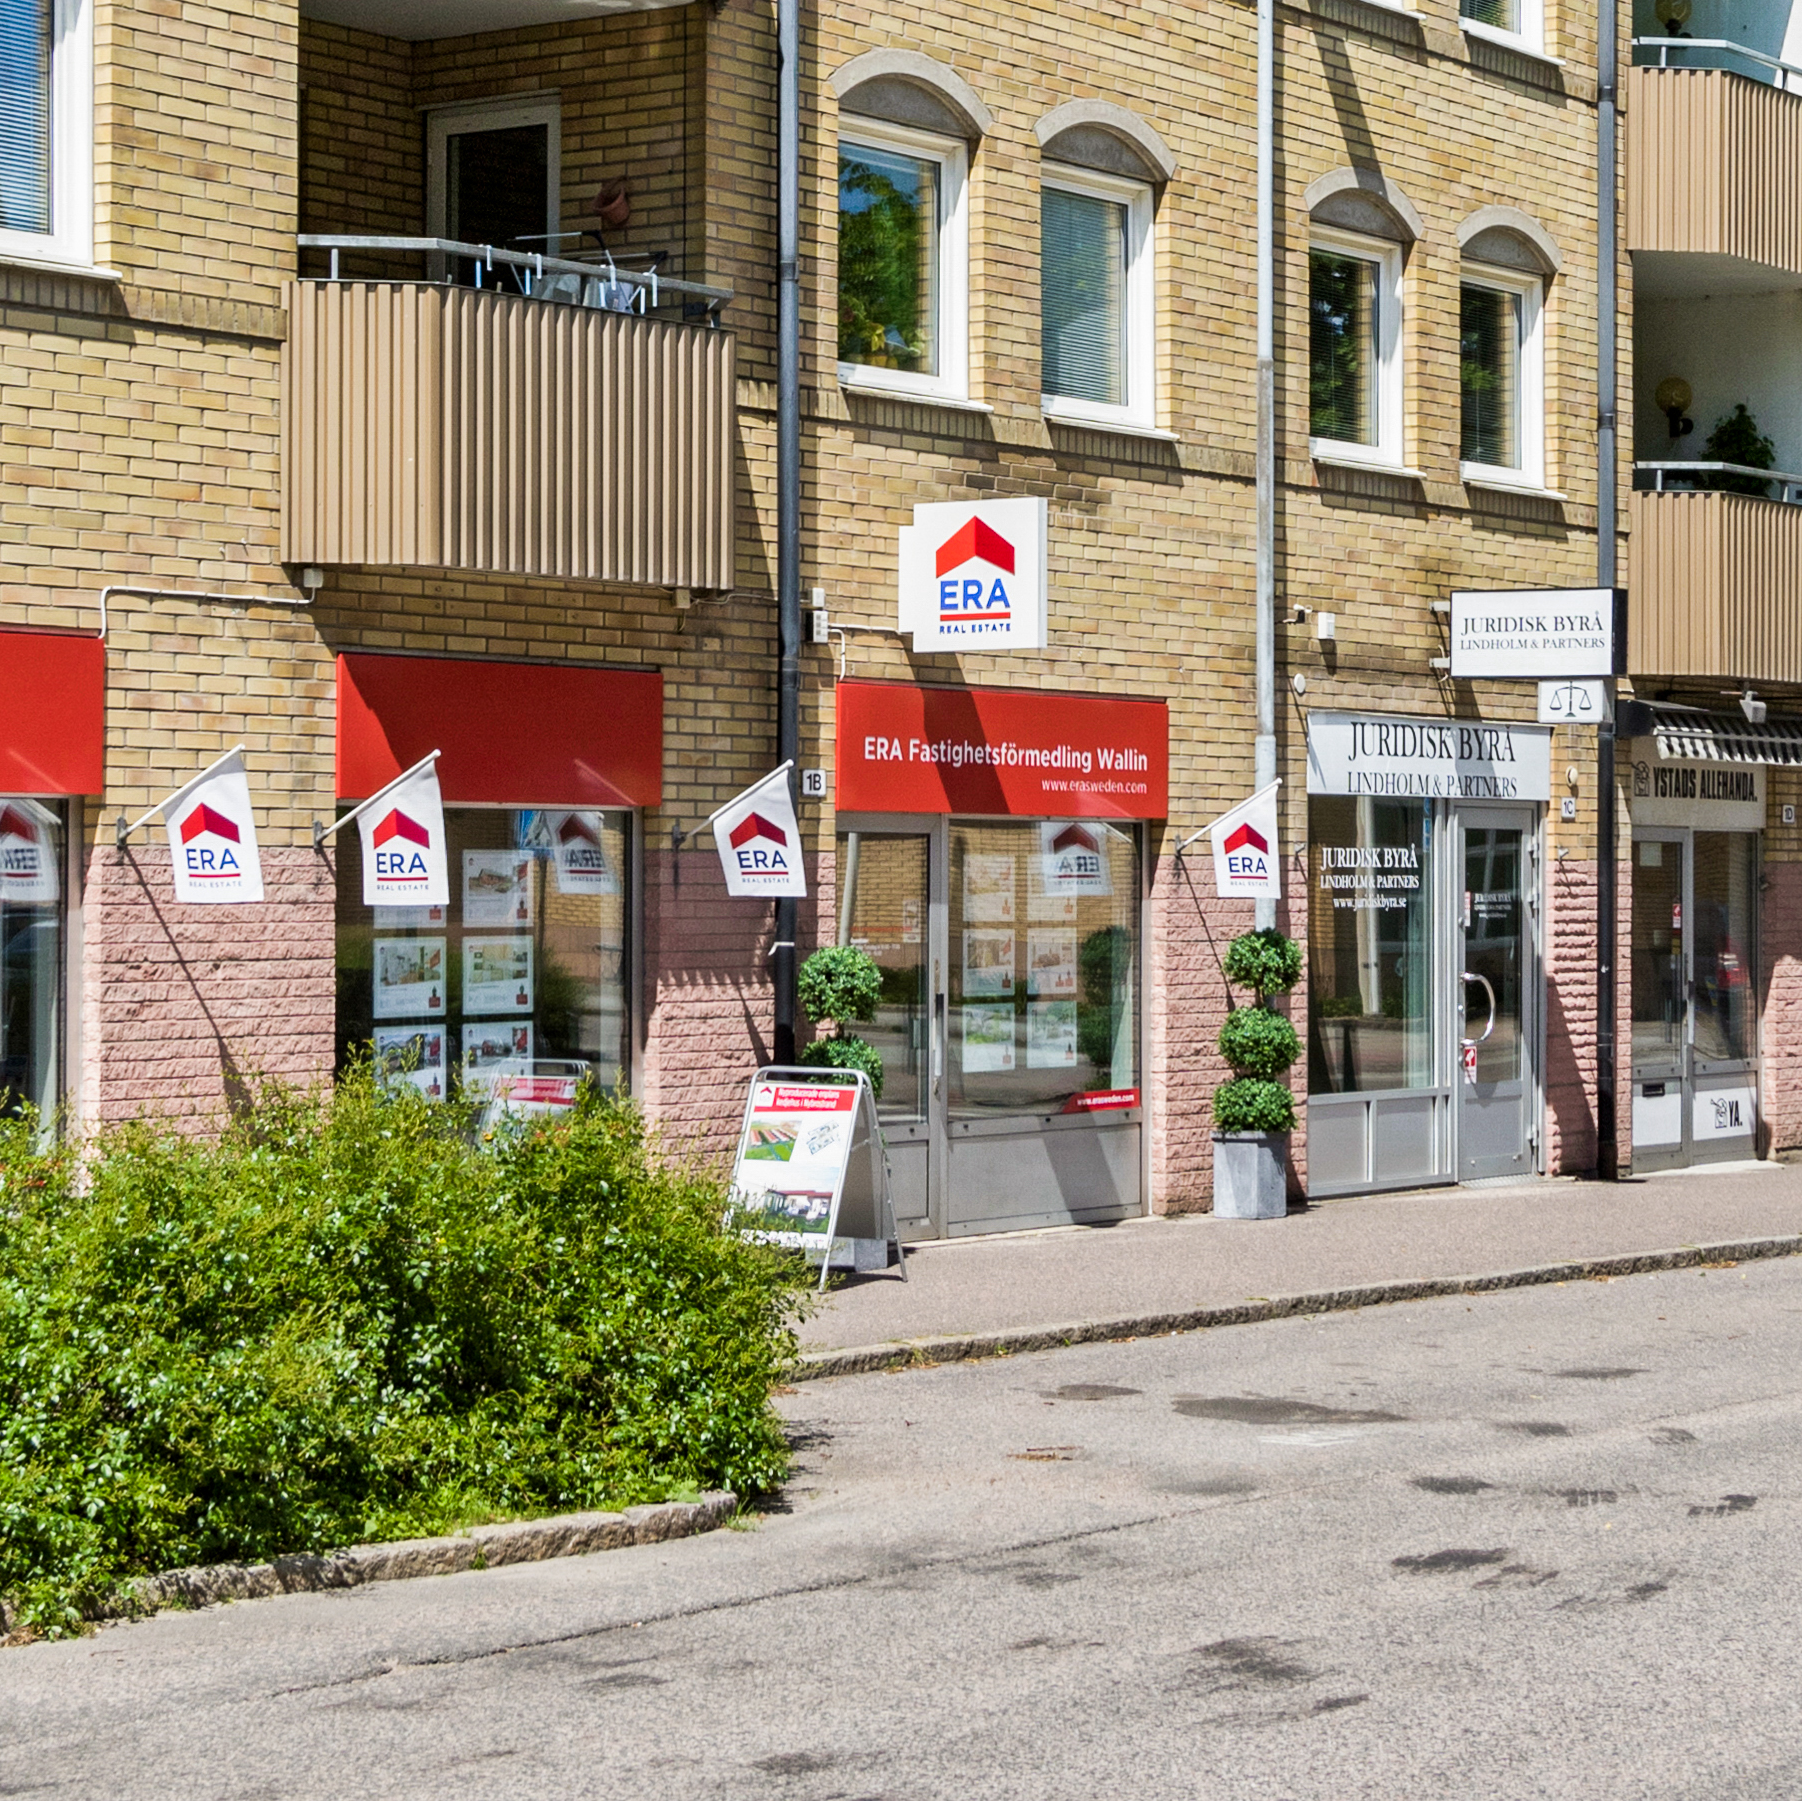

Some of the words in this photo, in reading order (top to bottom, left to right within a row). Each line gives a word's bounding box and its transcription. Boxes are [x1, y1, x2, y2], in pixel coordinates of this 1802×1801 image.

[940, 578, 1010, 610] ERA
[940, 624, 966, 634] REAL
[971, 623, 1011, 633] ESTATE
[1461, 616, 1547, 636] JURIDISK
[1553, 610, 1604, 632] BYRÅ
[1460, 639, 1528, 650] LINDHOLM
[1530, 639, 1539, 649] &
[1542, 638, 1605, 649] PARTNERS
[1348, 721, 1453, 761] JURIDISK
[1458, 724, 1516, 762] BYRÅ
[864, 736, 903, 761] ERA
[908, 738, 1092, 773] Fastighetsförmedling
[1097, 747, 1148, 772] Wallin
[806, 773, 822, 791] 1B
[1041, 778, 1148, 794] www.erasweden.com
[1348, 771, 1430, 795] LINDHOLM
[1432, 775, 1442, 796] &
[1446, 775, 1517, 798] PARTNERS
[1653, 766, 1696, 798] YSTADS
[1700, 769, 1758, 802] ALLEHANDA.
[1563, 800, 1574, 815] 1C
[1784, 806, 1794, 820] 1D
[186, 848, 240, 870] ERA
[376, 852, 428, 874] ERA
[736, 850, 788, 869] ERA
[1228, 857, 1268, 874] ERA
[1320, 846, 1382, 871] JURIDISK
[1383, 843, 1419, 868] BYRÅ
[209, 880, 242, 888] ESTATE
[1320, 875, 1367, 889] LINDHOLM
[1376, 875, 1420, 889] PARTNERS
[1728, 1100, 1743, 1128] YA.
